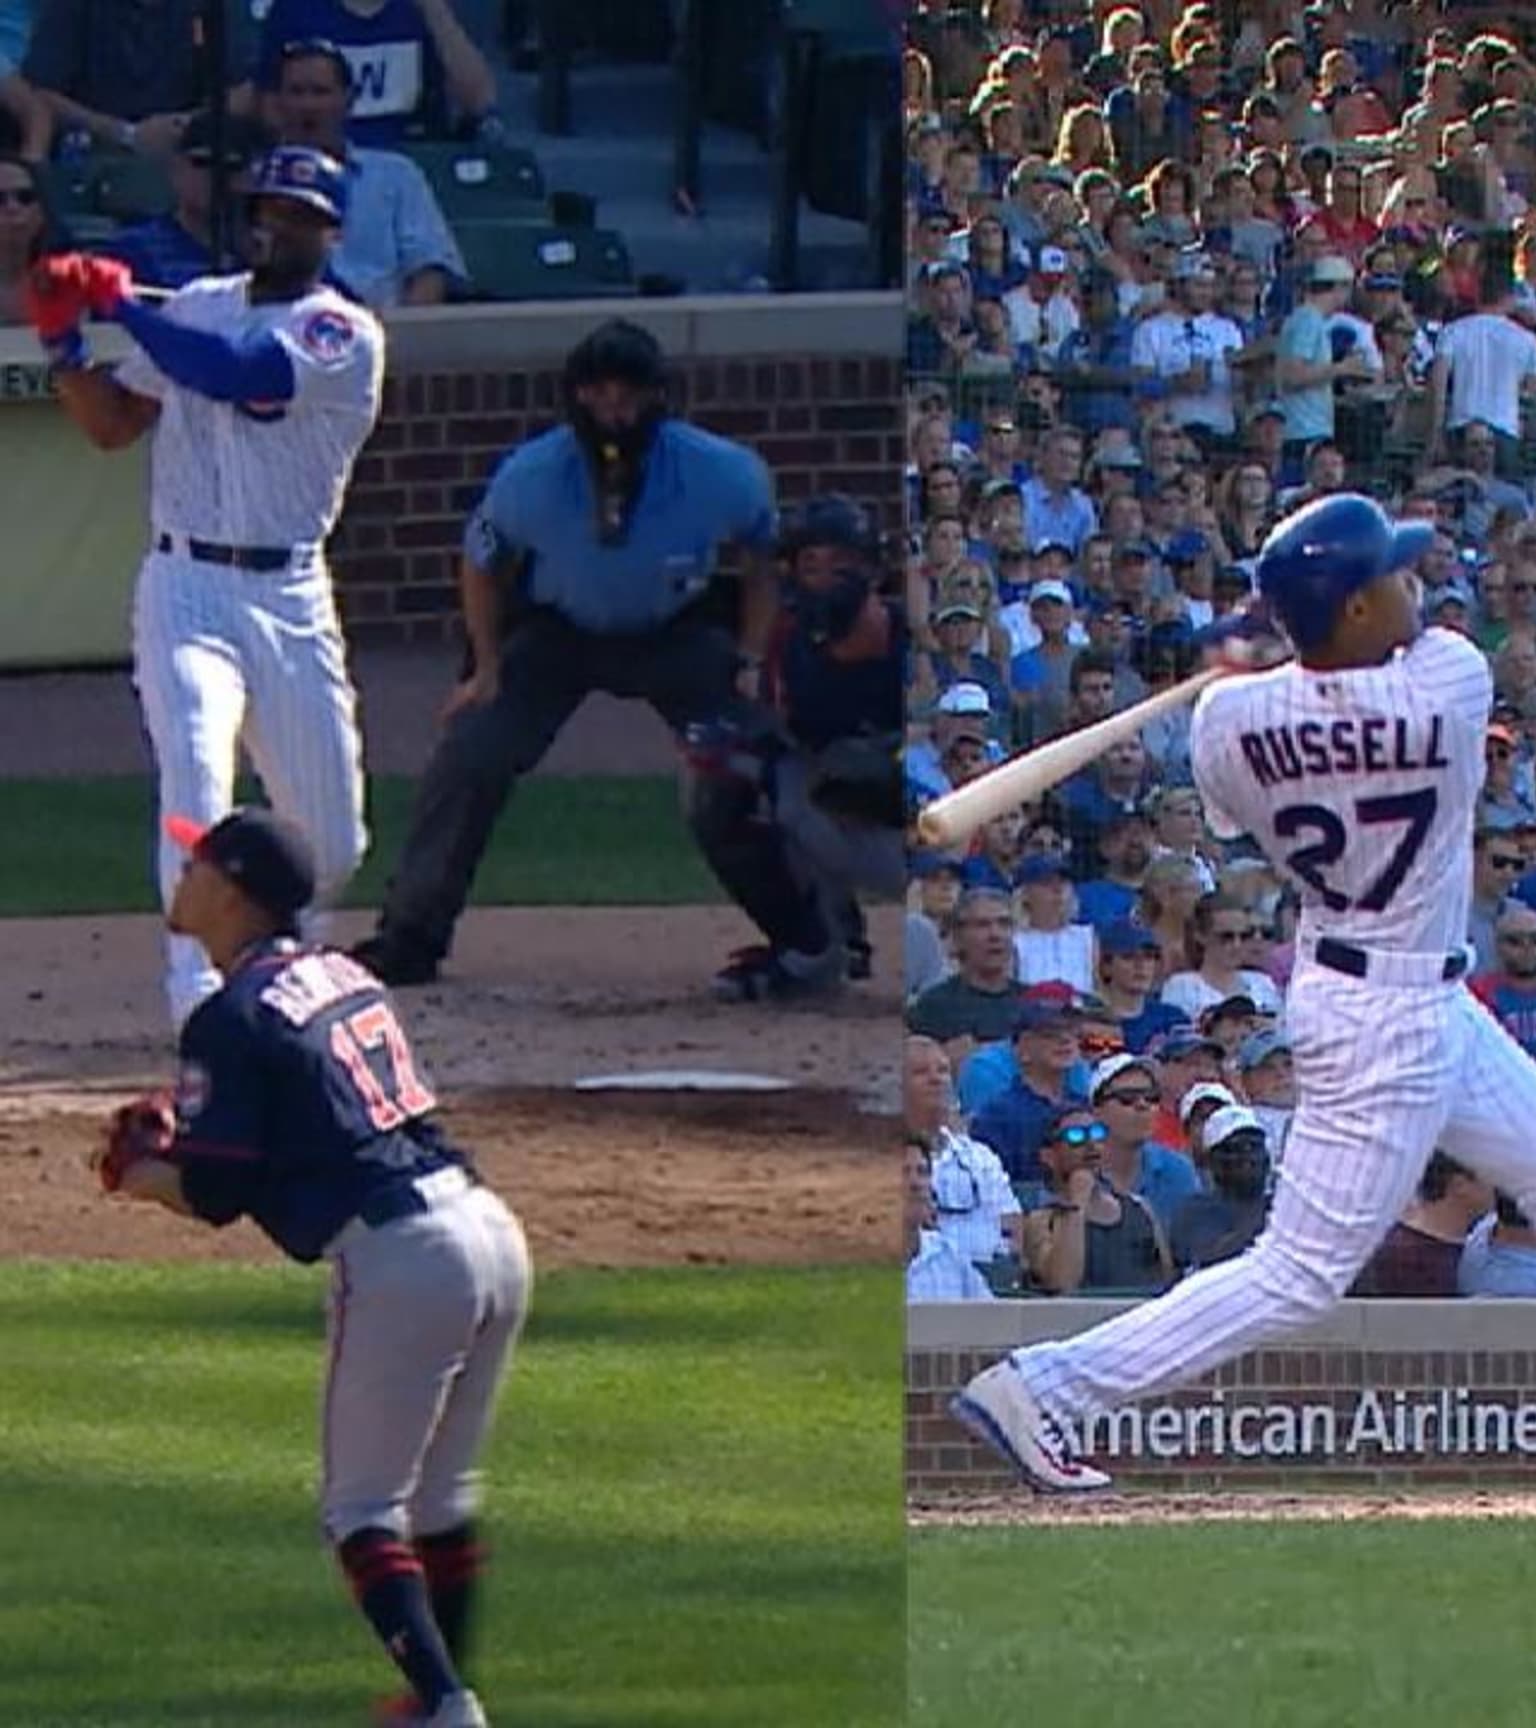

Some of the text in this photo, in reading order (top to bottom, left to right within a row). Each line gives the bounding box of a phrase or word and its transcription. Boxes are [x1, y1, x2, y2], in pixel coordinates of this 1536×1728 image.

[1239, 713, 1449, 788] RUSSELL
[1273, 786, 1438, 913] 27
[330, 1001, 436, 1131] 17
